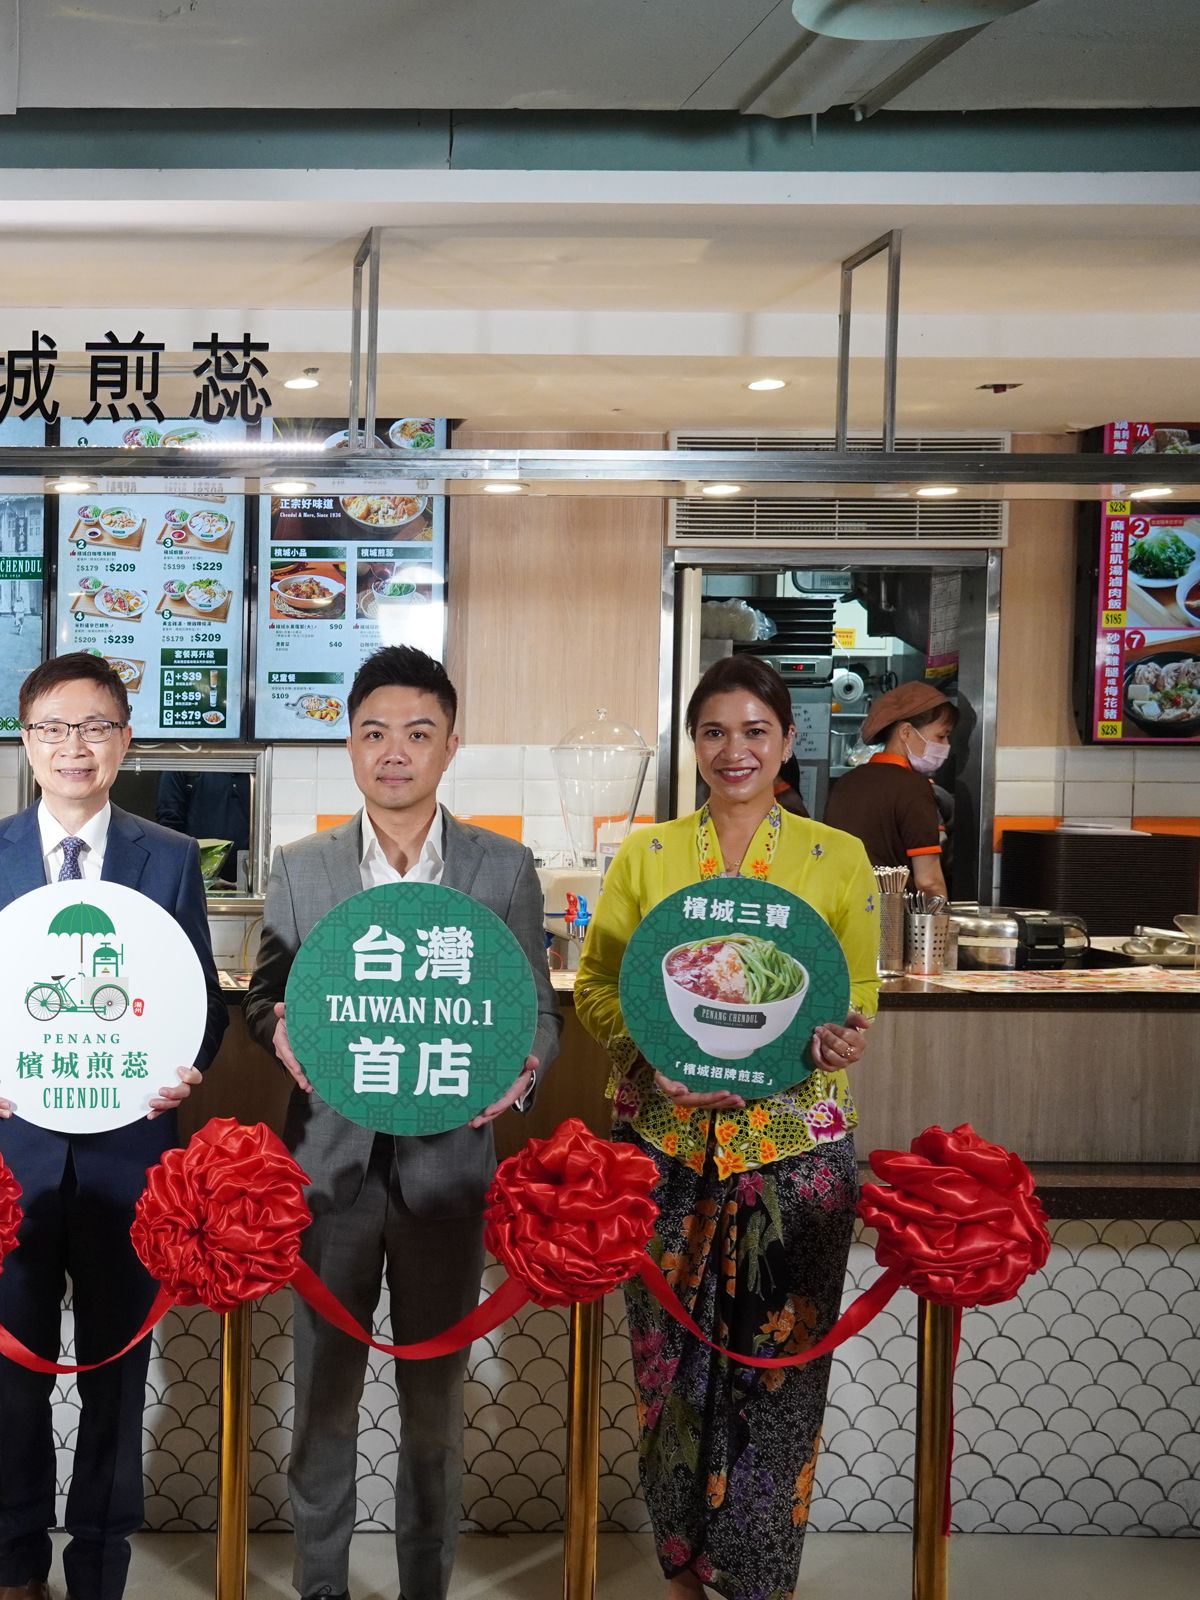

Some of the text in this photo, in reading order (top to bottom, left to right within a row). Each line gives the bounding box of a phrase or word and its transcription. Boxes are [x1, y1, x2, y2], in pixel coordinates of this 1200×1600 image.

[1136, 424, 1150, 437] 7A
[279, 498, 334, 510] 正宗好味道
[1134, 521, 1145, 535] 2
[274, 548, 307, 557] 檳城小品
[361, 548, 394, 557] 檳城煎蕊
[0, 560, 42, 573] CHENDUL
[109, 563, 136, 572] $209
[196, 562, 223, 571] $229
[1105, 614, 1122, 625] $185
[108, 635, 135, 644] $239
[194, 634, 222, 643] $209
[1130, 634, 1142, 649] 7
[174, 650, 215, 659] 套餐再升級
[166, 672, 173, 681] A
[175, 672, 202, 681] +$39
[272, 674, 296, 683] 兒童餐
[166, 693, 172, 701] B
[175, 692, 202, 701] +$59
[165, 712, 172, 720] C
[174, 710, 202, 721] +$79
[682, 895, 791, 929] 檳城三寶
[352, 925, 475, 985] 台灣
[326, 994, 494, 1026] TAIWAN NO.1
[702, 1008, 759, 1024] PENANG CHENDUL
[43, 1033, 121, 1045] PENANG
[16, 1051, 149, 1080] 檳城煎蕊
[348, 1035, 473, 1098] 首店
[43, 1087, 121, 1109] CHENDUL
